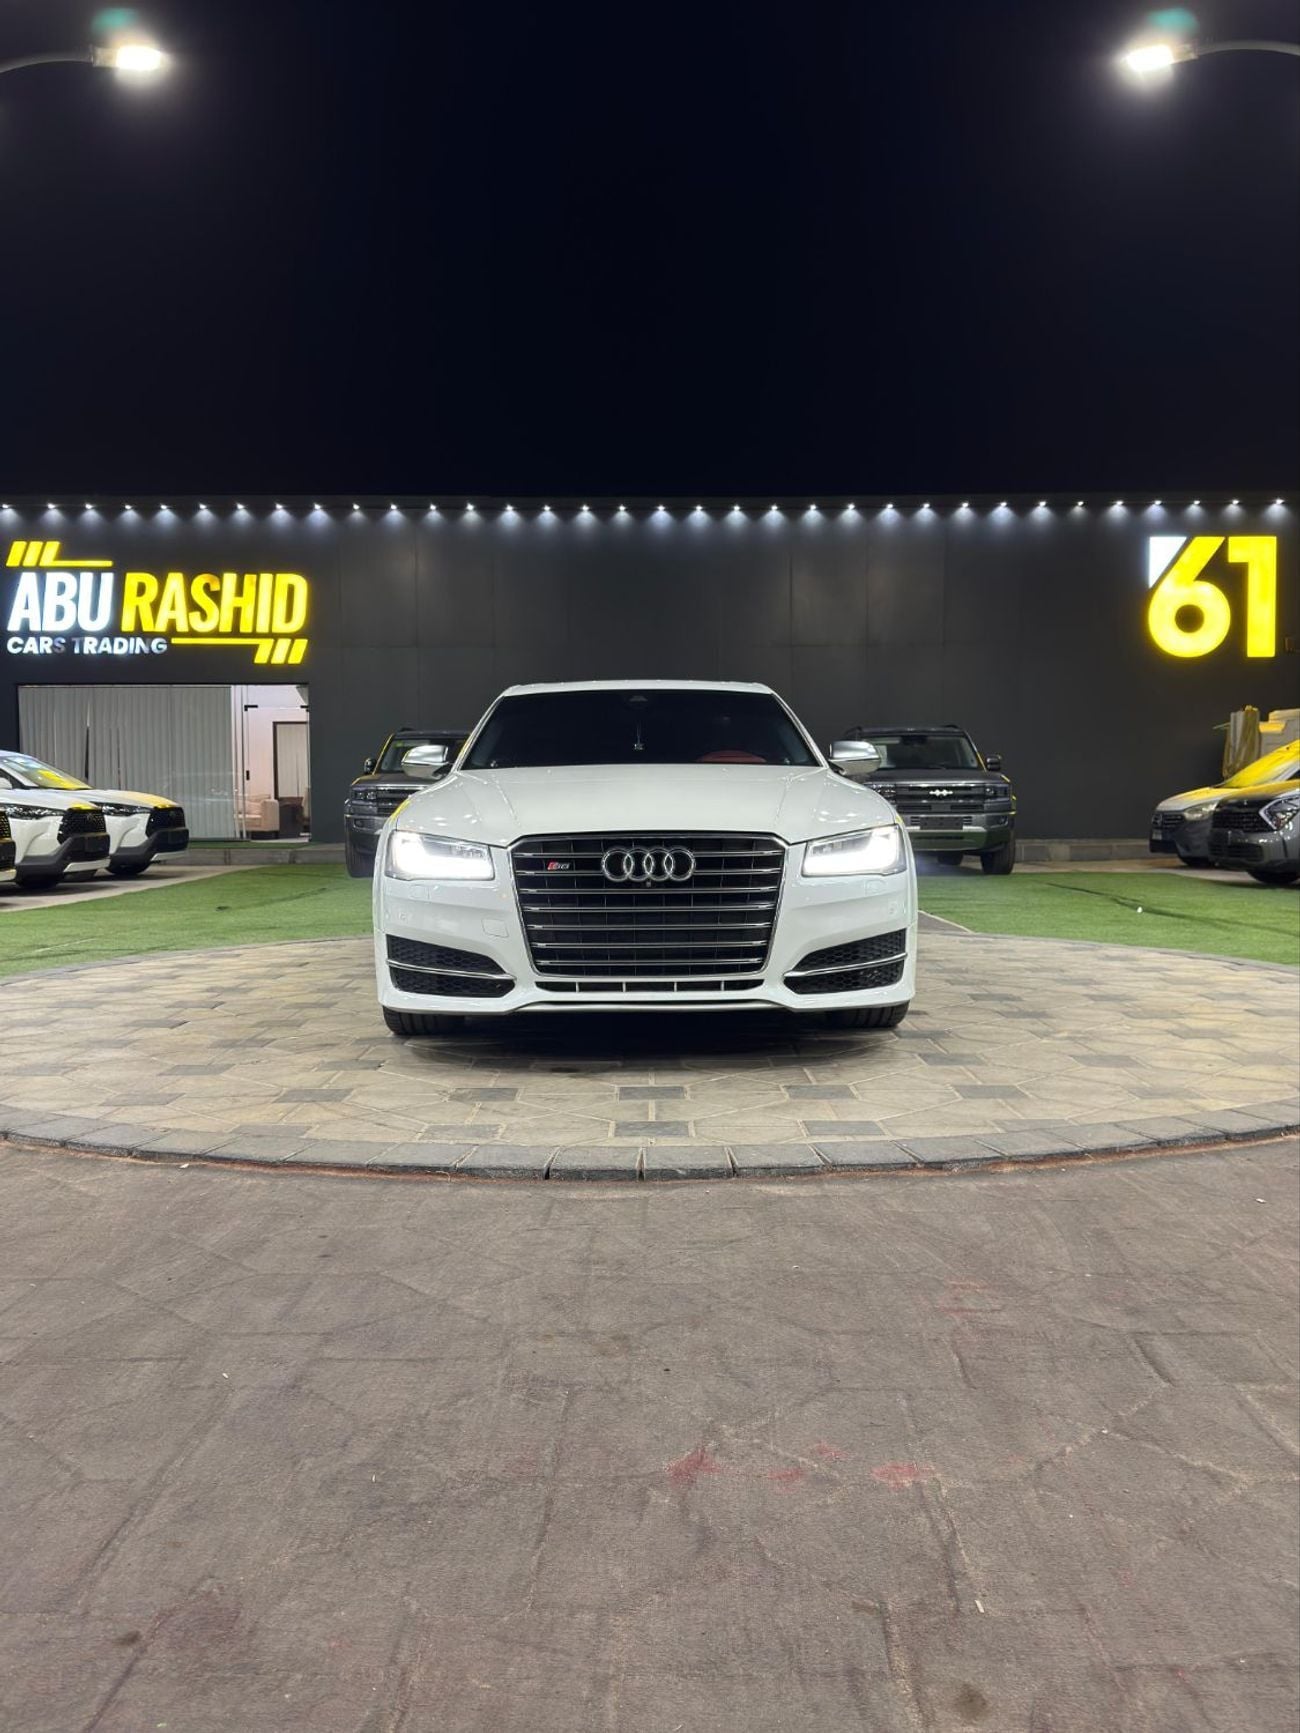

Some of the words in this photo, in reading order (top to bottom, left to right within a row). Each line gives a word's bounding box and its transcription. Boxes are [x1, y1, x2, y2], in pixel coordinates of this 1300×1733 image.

[7, 571, 114, 633] ABU
[121, 571, 309, 634] RASHID
[1147, 536, 1278, 658] 61
[7, 636, 66, 655] CARS
[72, 636, 168, 655] TRADING
